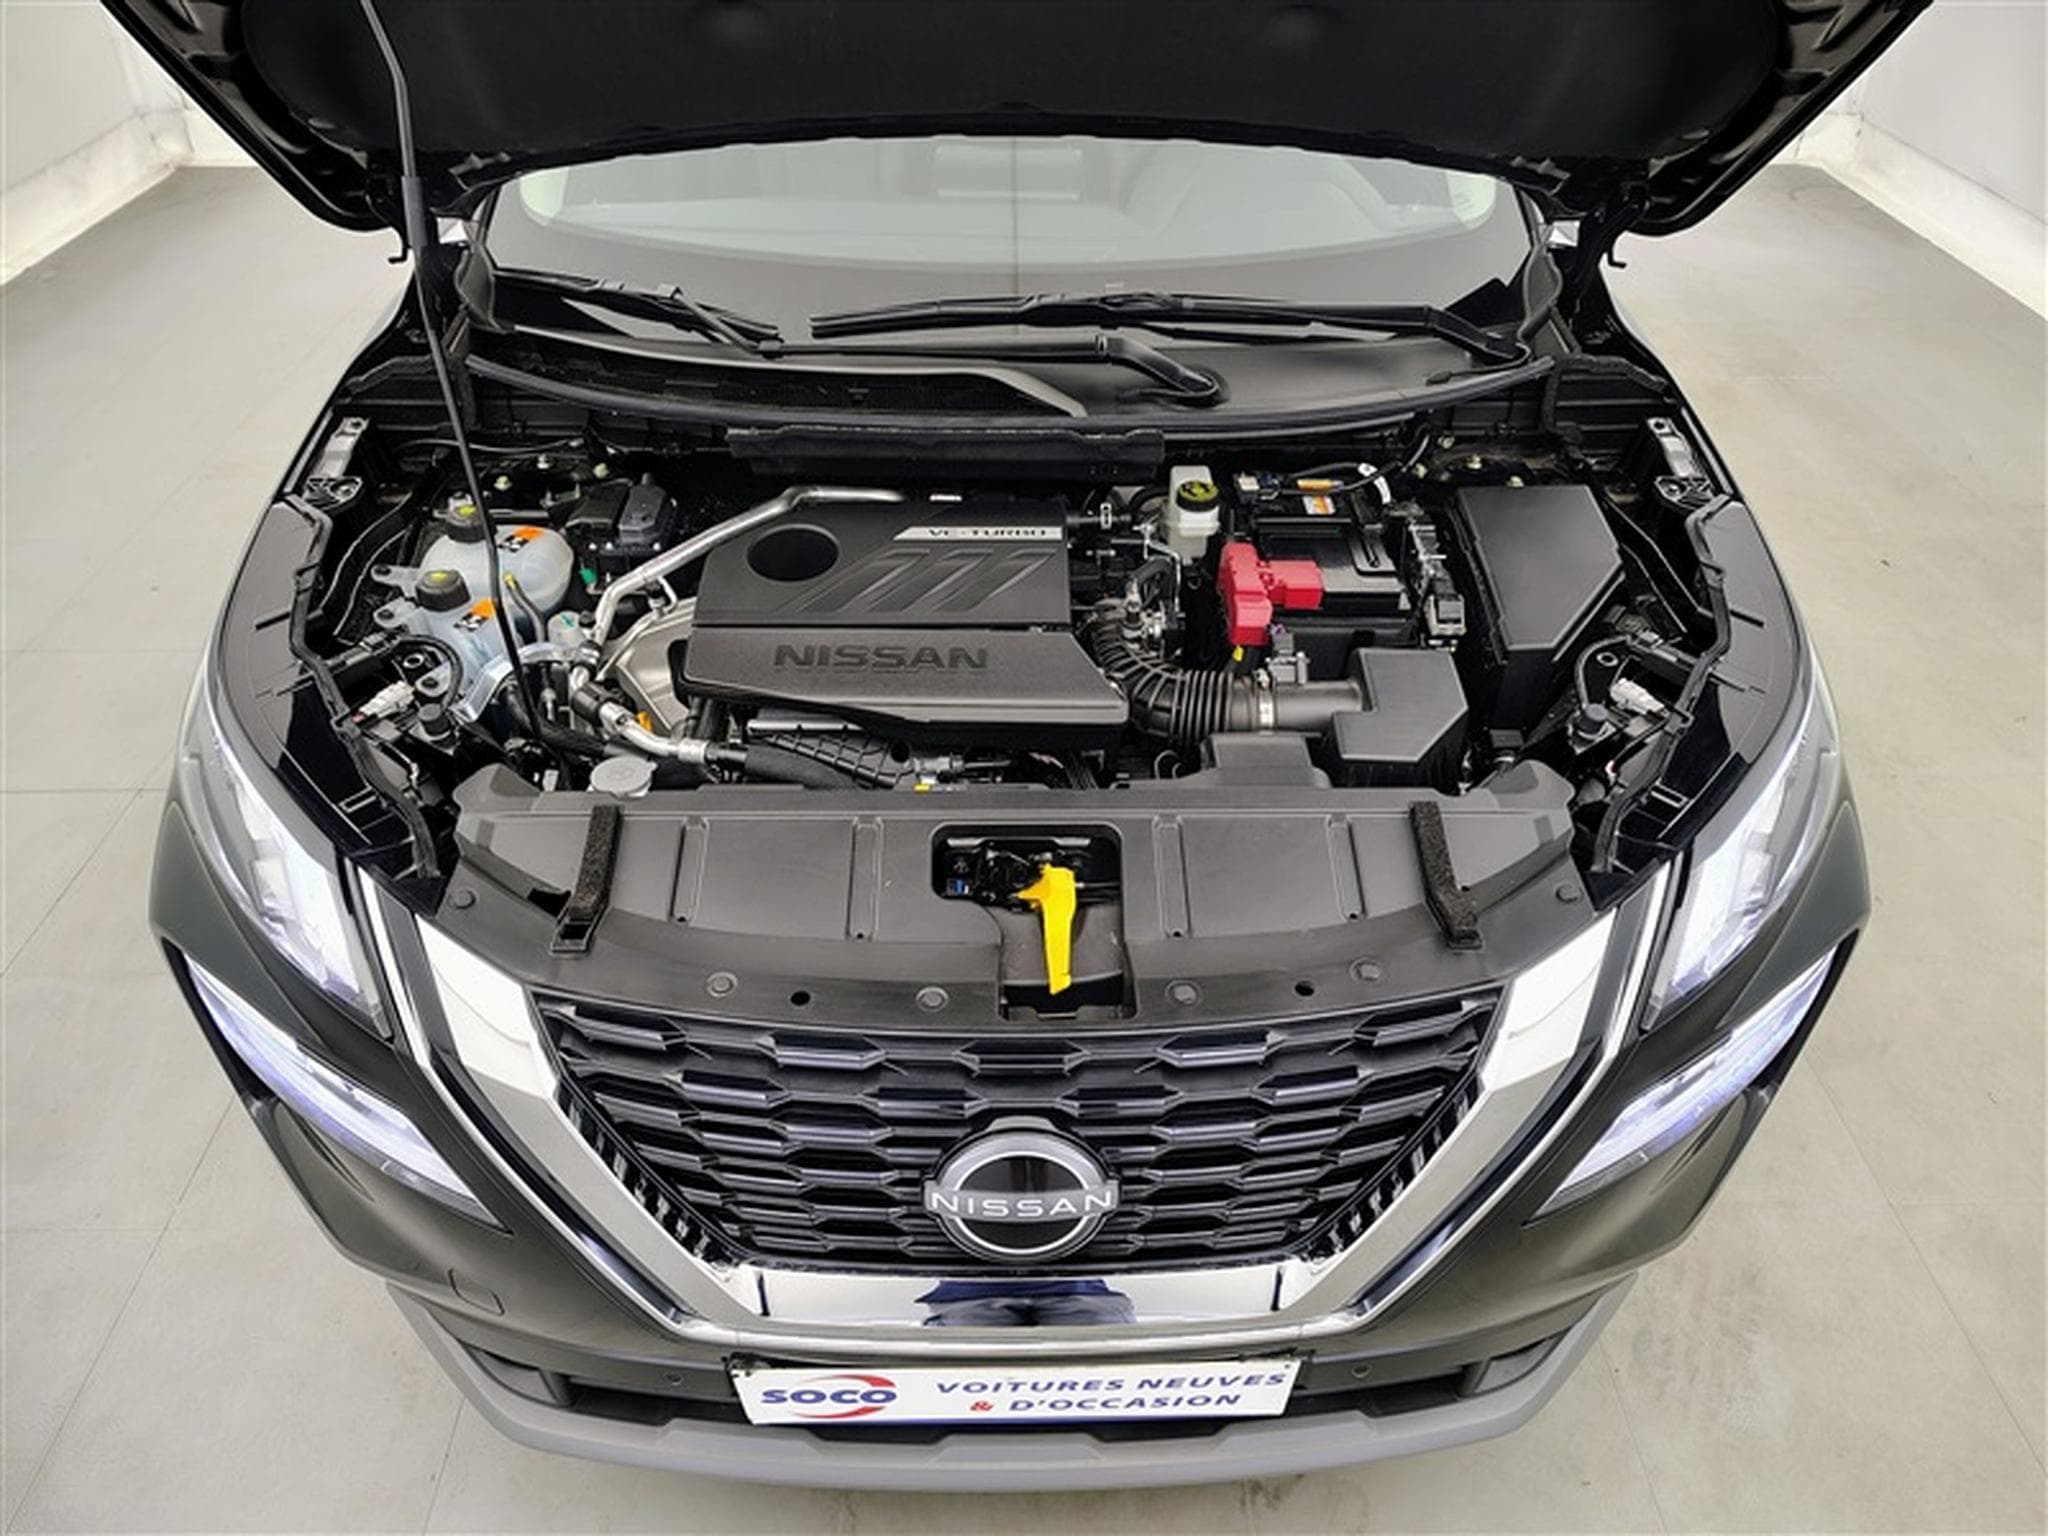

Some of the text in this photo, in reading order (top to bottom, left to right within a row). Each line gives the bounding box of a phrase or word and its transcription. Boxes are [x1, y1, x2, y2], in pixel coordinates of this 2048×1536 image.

[773, 643, 988, 673] NISSAN
[931, 1191, 1112, 1217] NISSAN
[936, 1373, 1287, 1394] VOITURES NEUVES
[761, 1389, 897, 1404] SOCO
[969, 1394, 1241, 1412] & D'OCCASION
